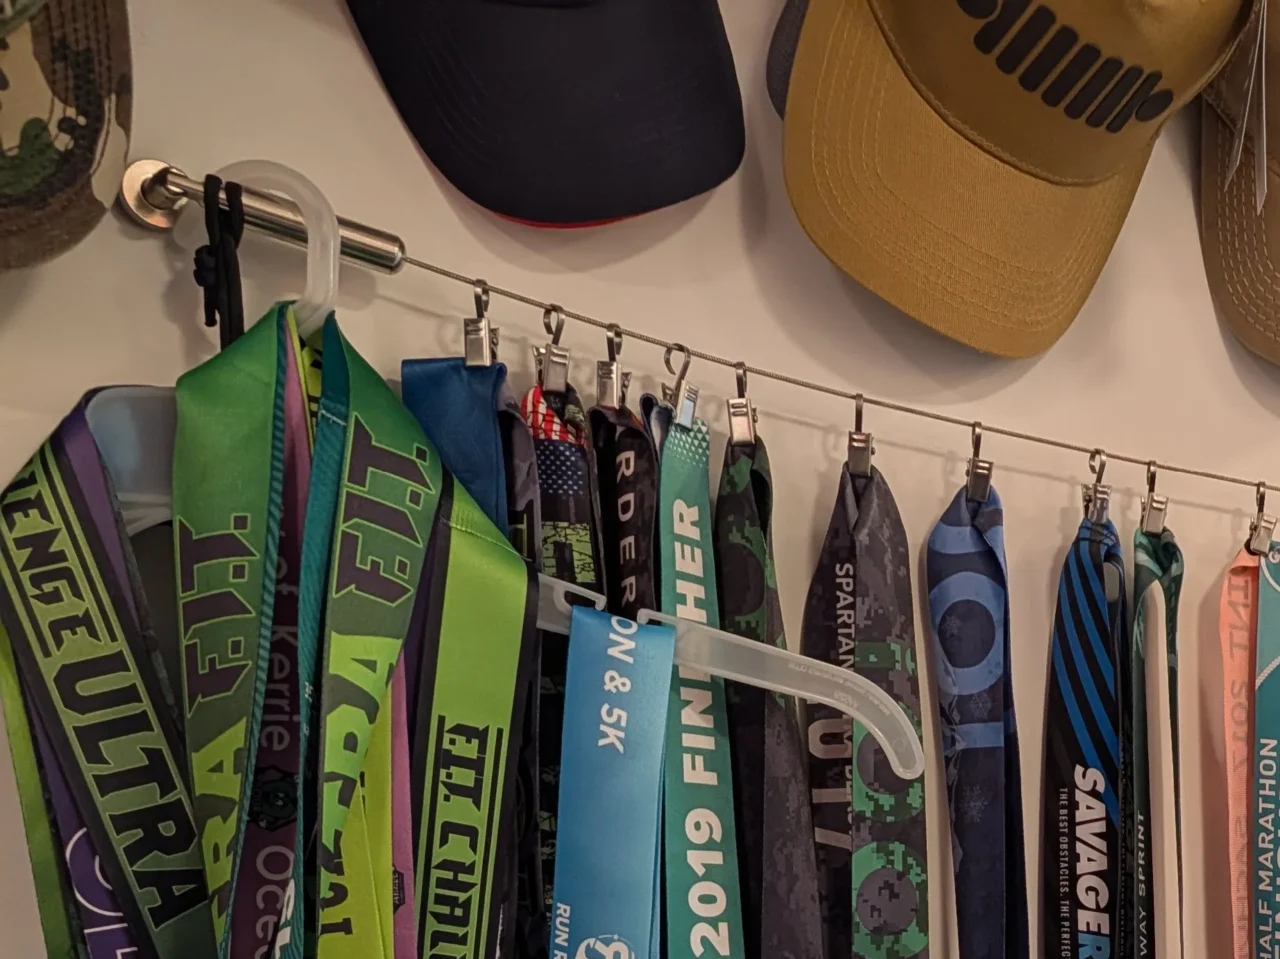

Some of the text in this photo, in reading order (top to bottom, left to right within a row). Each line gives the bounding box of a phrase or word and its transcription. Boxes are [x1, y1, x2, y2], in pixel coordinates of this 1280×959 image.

[834, 562, 855, 672] SPARTAN
[258, 622, 302, 752] Kerrie
[597, 616, 638, 754] ON & 5K
[53, 647, 209, 930] ULTRA
[1058, 787, 1068, 802] THE
[1058, 804, 1069, 830] BEST
[1257, 738, 1278, 892] MARATHON
[684, 807, 730, 957] 2019
[1058, 836, 1070, 897] OBSTACLES.
[1137, 810, 1148, 898] SPRINT
[555, 902, 571, 949] RUN
[1060, 900, 1070, 918] THE
